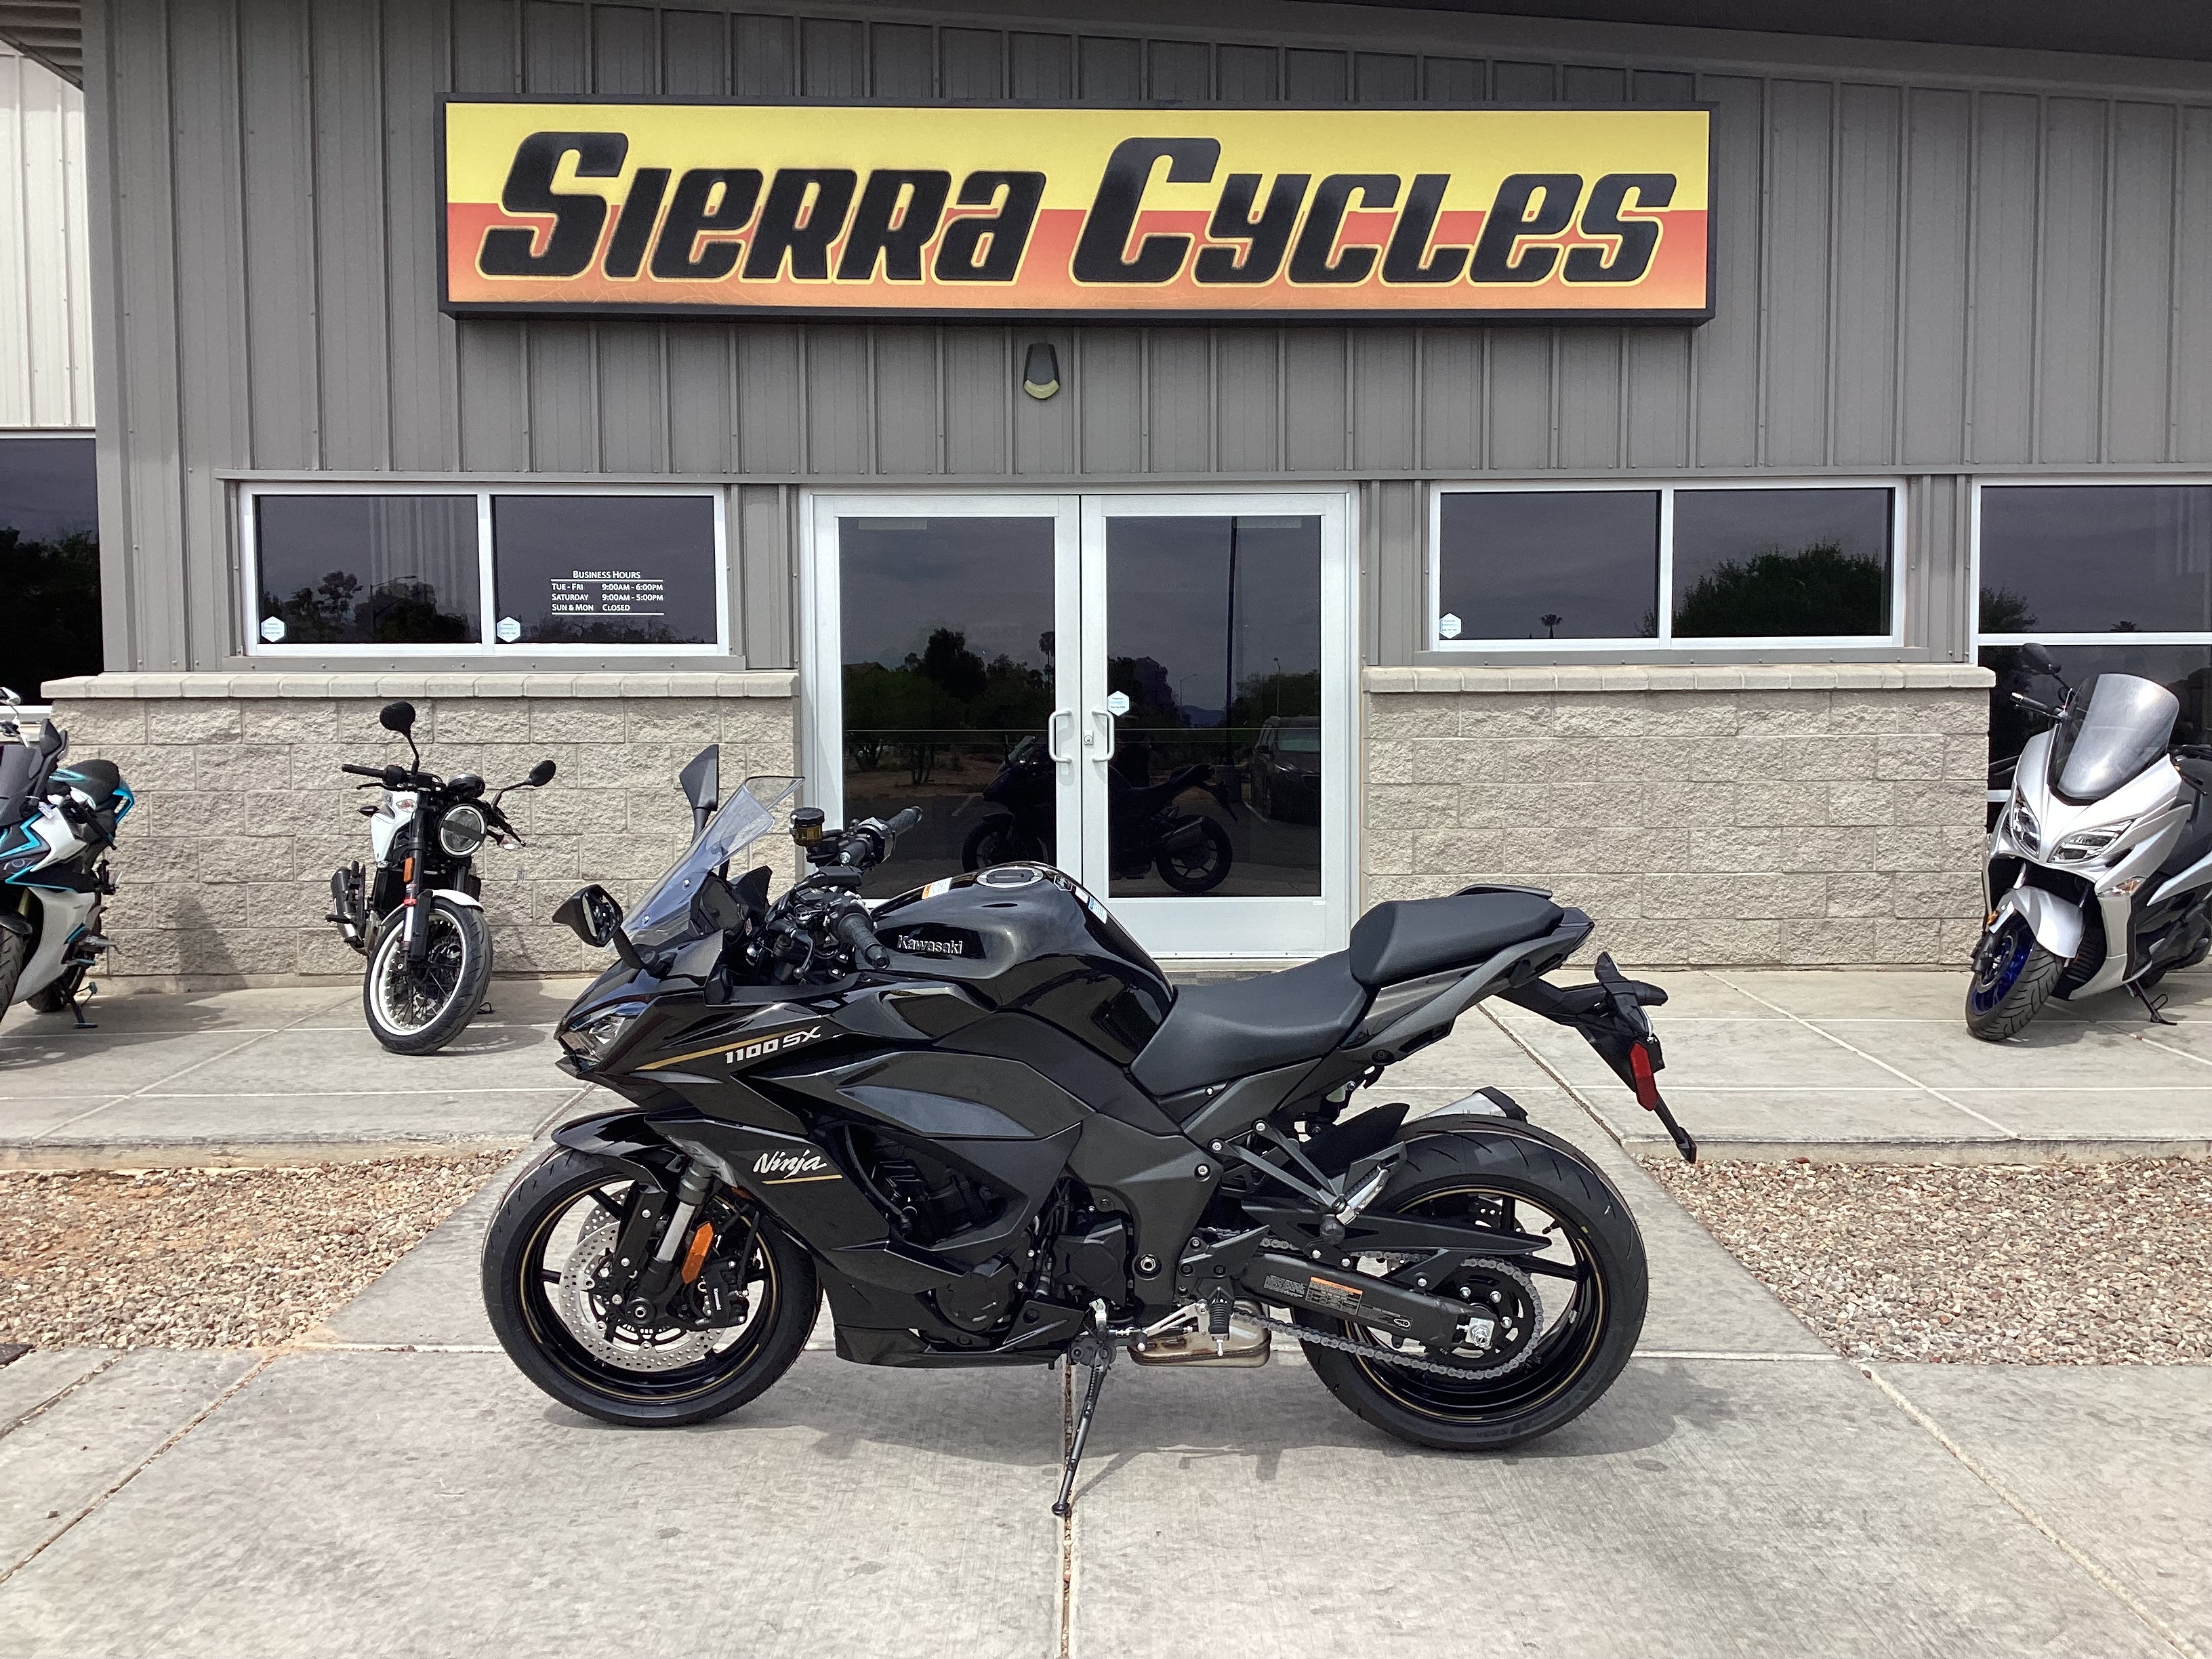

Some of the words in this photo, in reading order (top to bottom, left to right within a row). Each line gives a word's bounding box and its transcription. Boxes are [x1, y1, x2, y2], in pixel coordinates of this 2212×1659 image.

[551, 583, 567, 591] TUE
[571, 583, 583, 591] FRI
[601, 583, 630, 591] 9:00AM
[551, 593, 589, 601] SATURDAY
[552, 603, 568, 611] SUN
[575, 603, 594, 611] MON
[602, 603, 631, 611] CLOSED
[897, 935, 963, 954] Kawasaki
[724, 1038, 779, 1064] 1100
[782, 1025, 821, 1048] SX
[752, 1149, 827, 1179] Ninja
